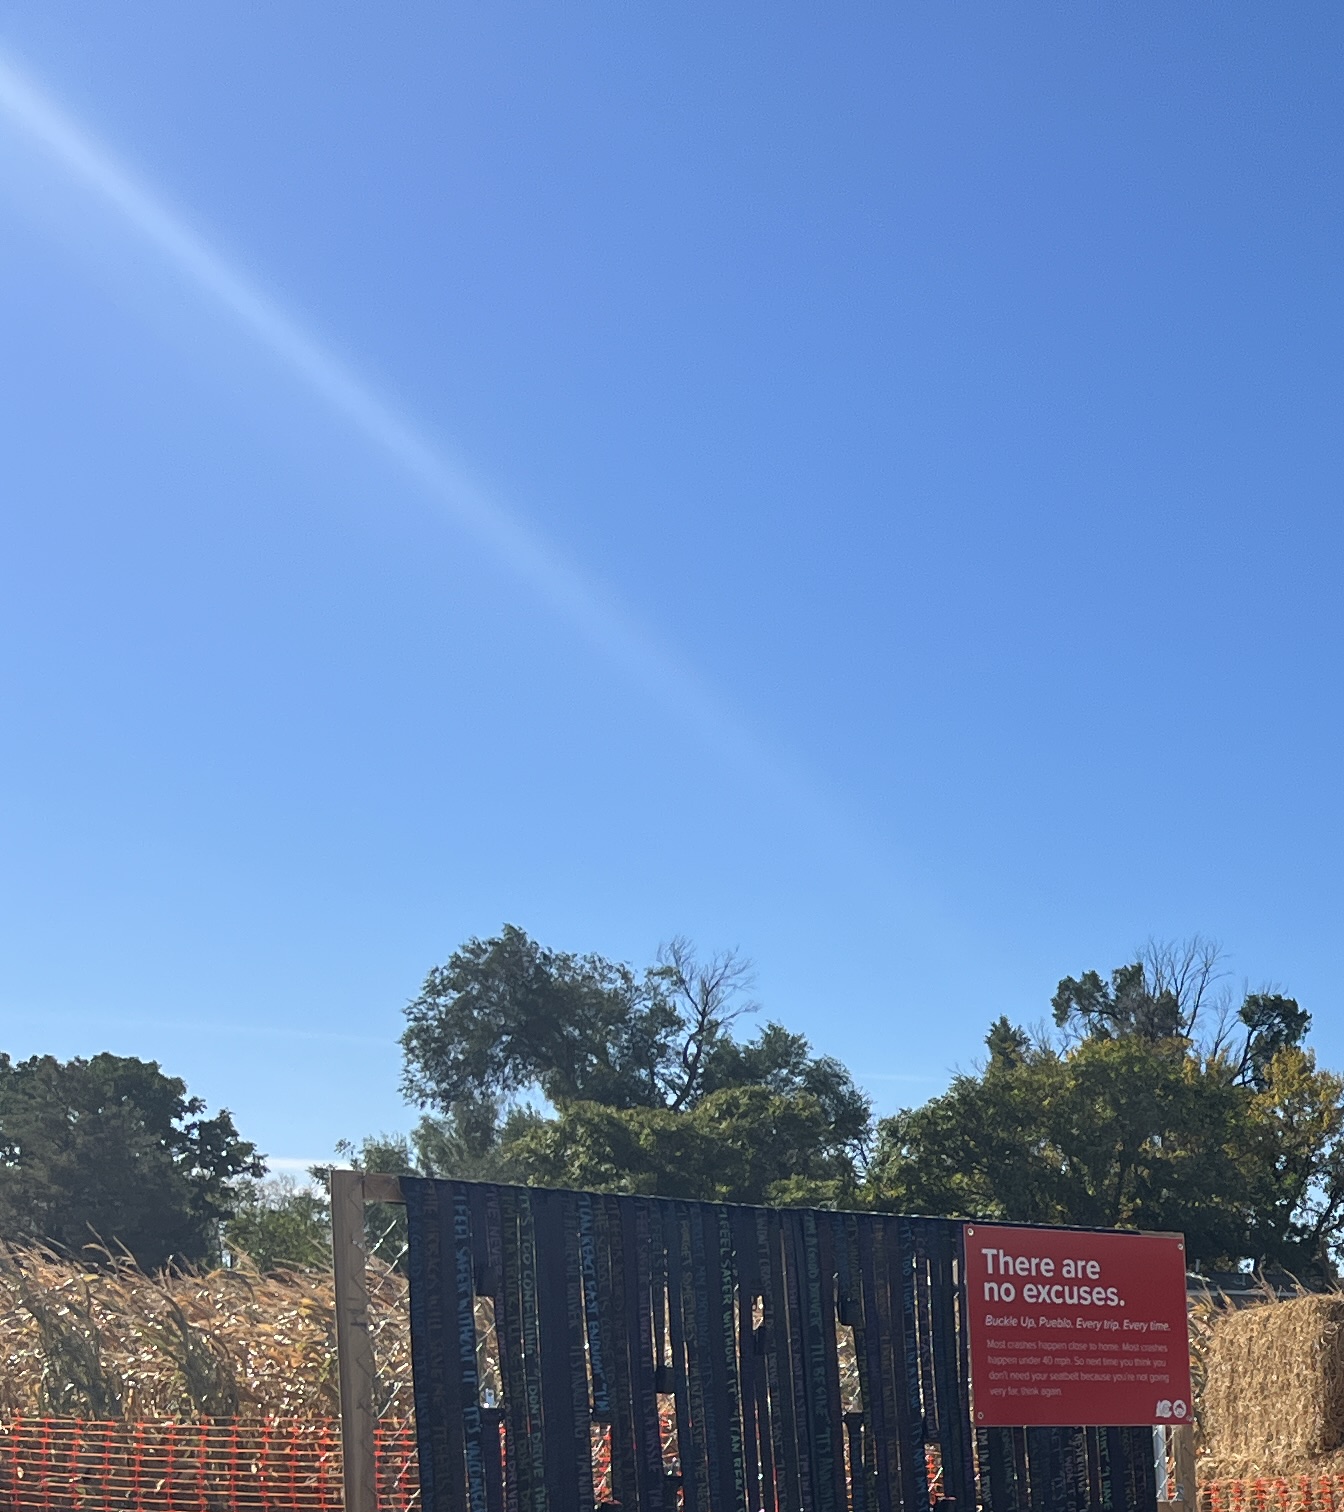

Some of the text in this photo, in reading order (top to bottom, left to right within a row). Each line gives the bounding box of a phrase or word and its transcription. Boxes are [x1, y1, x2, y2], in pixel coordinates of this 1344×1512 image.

[981, 1248, 1101, 1280] There are
[721, 1259, 733, 1305] SAFER
[984, 1281, 1125, 1307] no excuses.
[985, 1315, 1018, 1327] Buckle
[1076, 1318, 1102, 1331] Every
[1122, 1319, 1149, 1332] Every
[1150, 1320, 1171, 1331] time.
[721, 1310, 735, 1372] WITHOUT
